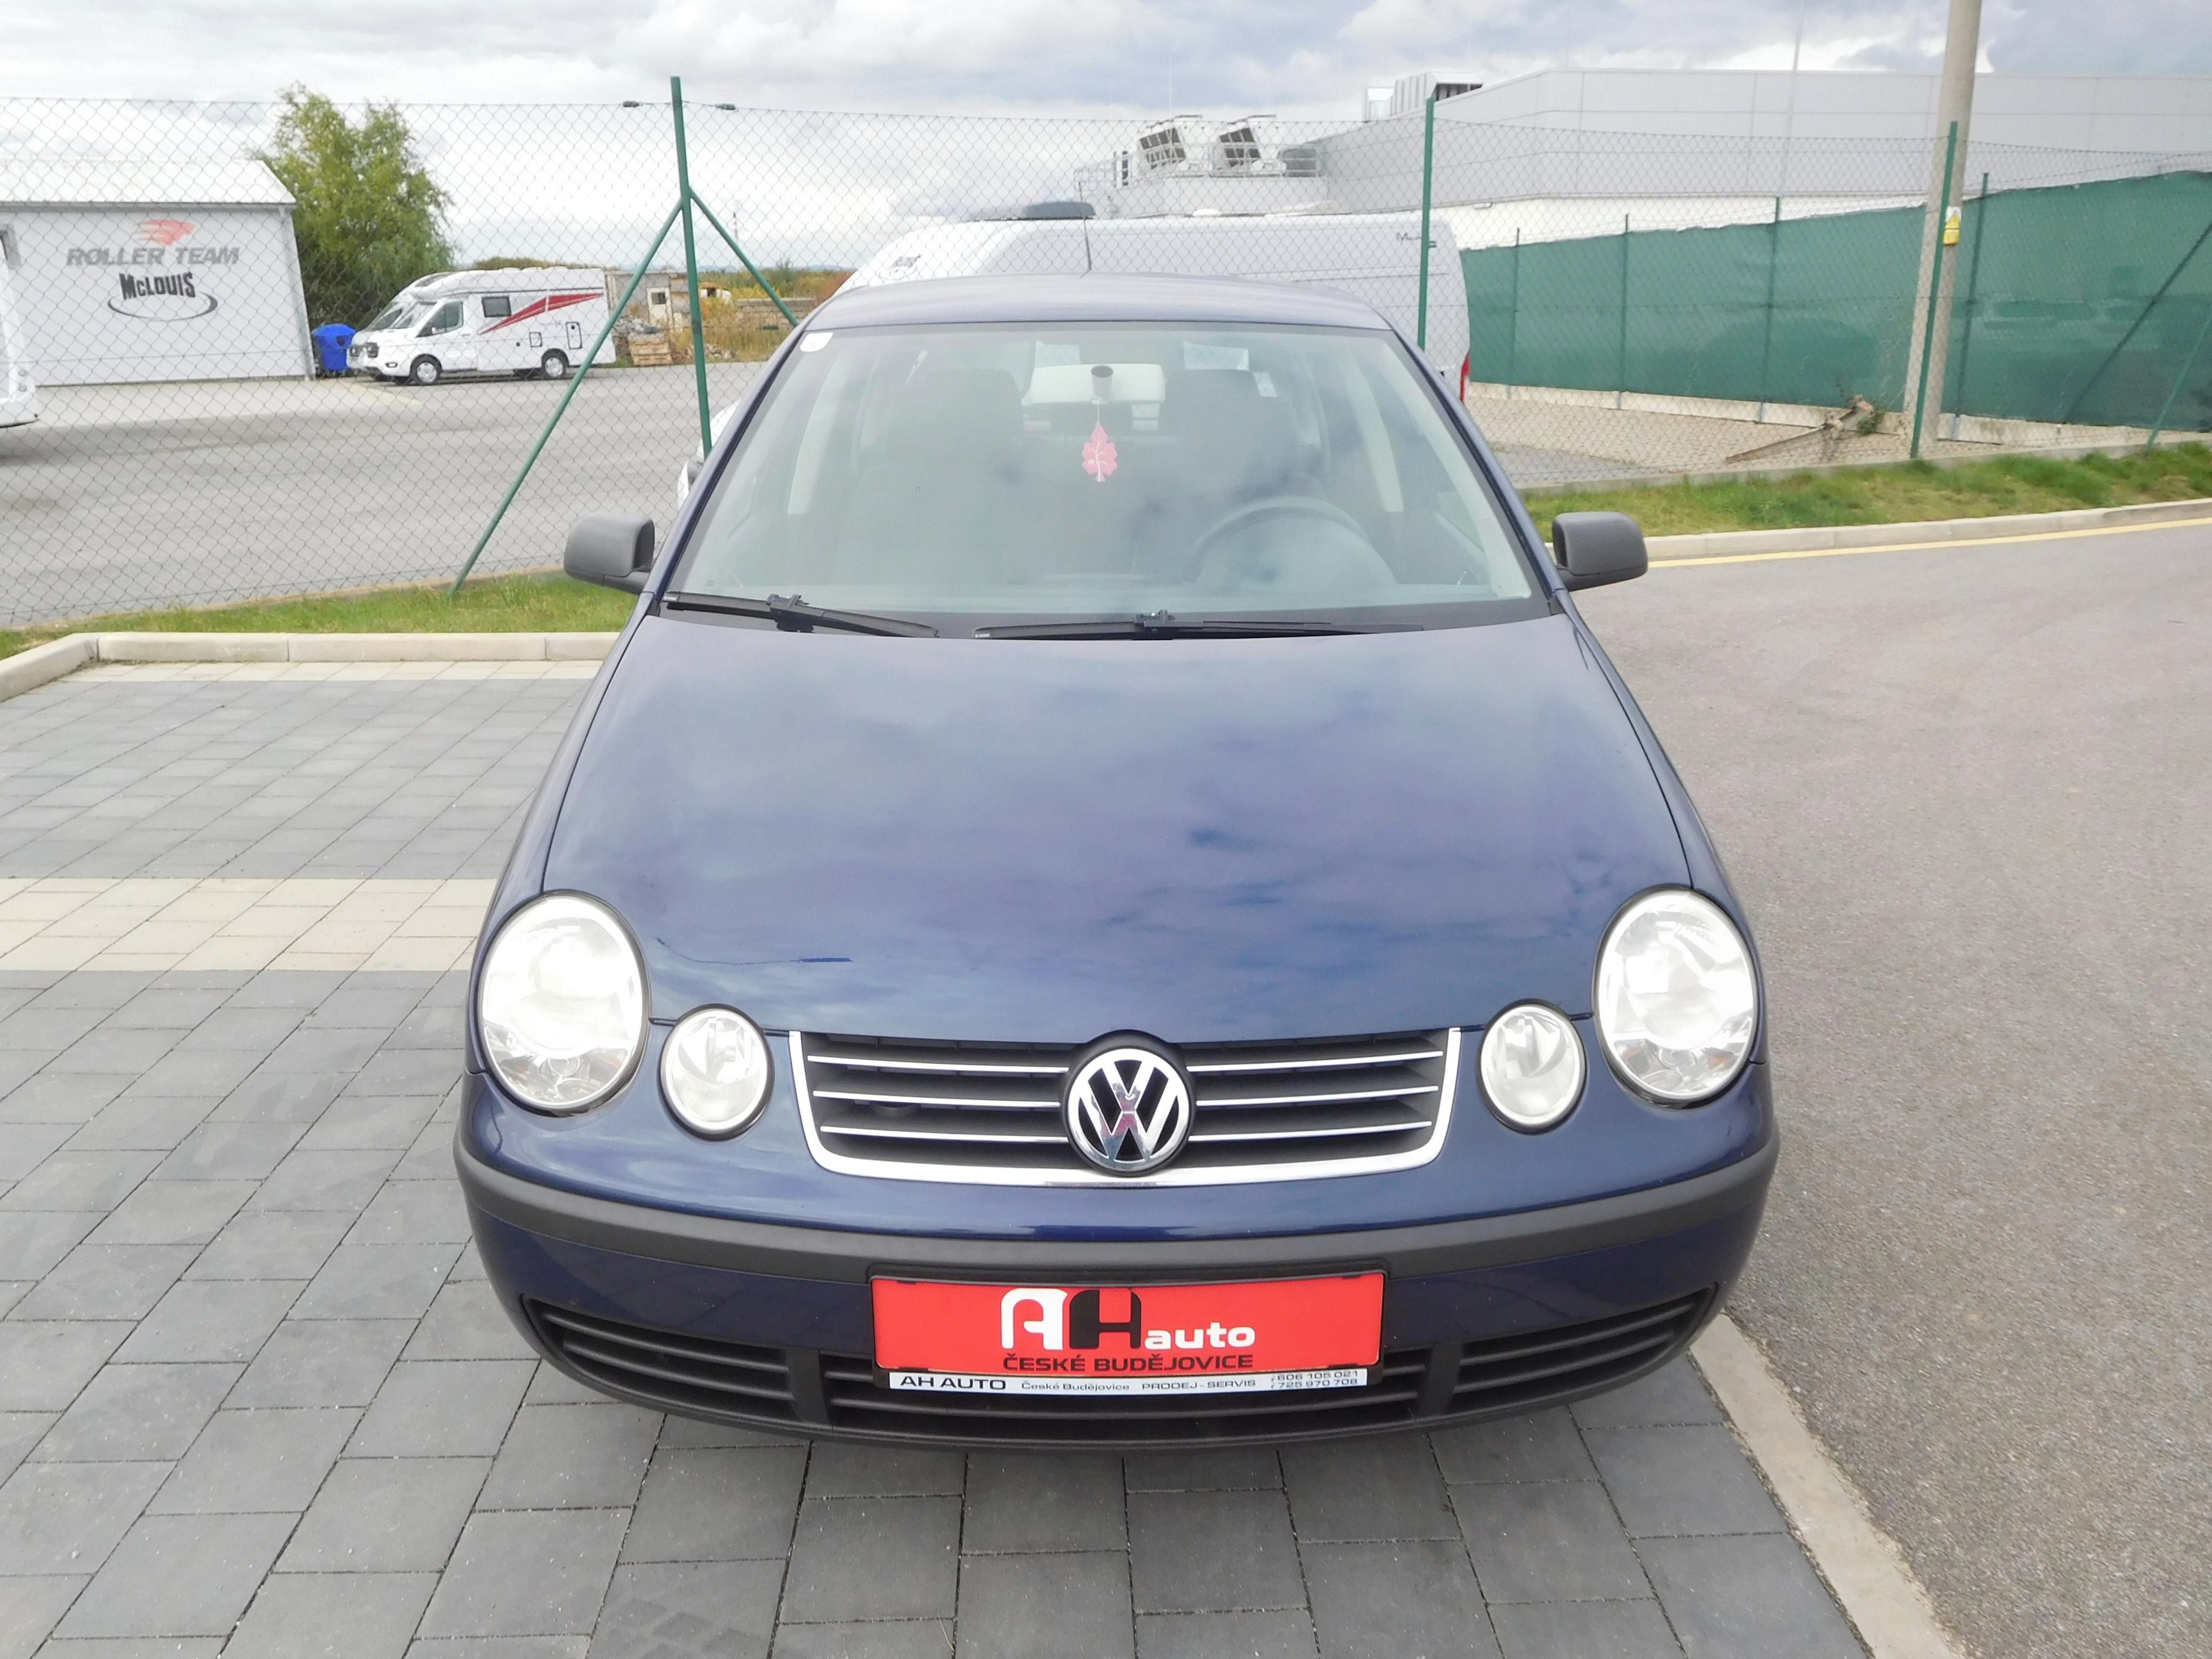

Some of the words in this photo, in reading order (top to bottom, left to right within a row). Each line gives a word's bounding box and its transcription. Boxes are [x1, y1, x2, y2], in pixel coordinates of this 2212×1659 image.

[66, 247, 165, 266] ROLLER
[175, 246, 240, 265] TEAM
[1073, 1052, 1185, 1166] VW
[1001, 1287, 1142, 1350] AH
[1144, 1321, 1256, 1350] auto
[1002, 1353, 1086, 1372] ČESKÉ
[1094, 1353, 1254, 1372] BUDĚJOVICE
[900, 1376, 934, 1387] AH
[940, 1378, 1006, 1390] AUTO
[1021, 1380, 1060, 1391] České
[1062, 1382, 1130, 1392] Budějovice
[1142, 1382, 1198, 1390] PRODEJ
[1207, 1379, 1256, 1389] SERVIS
